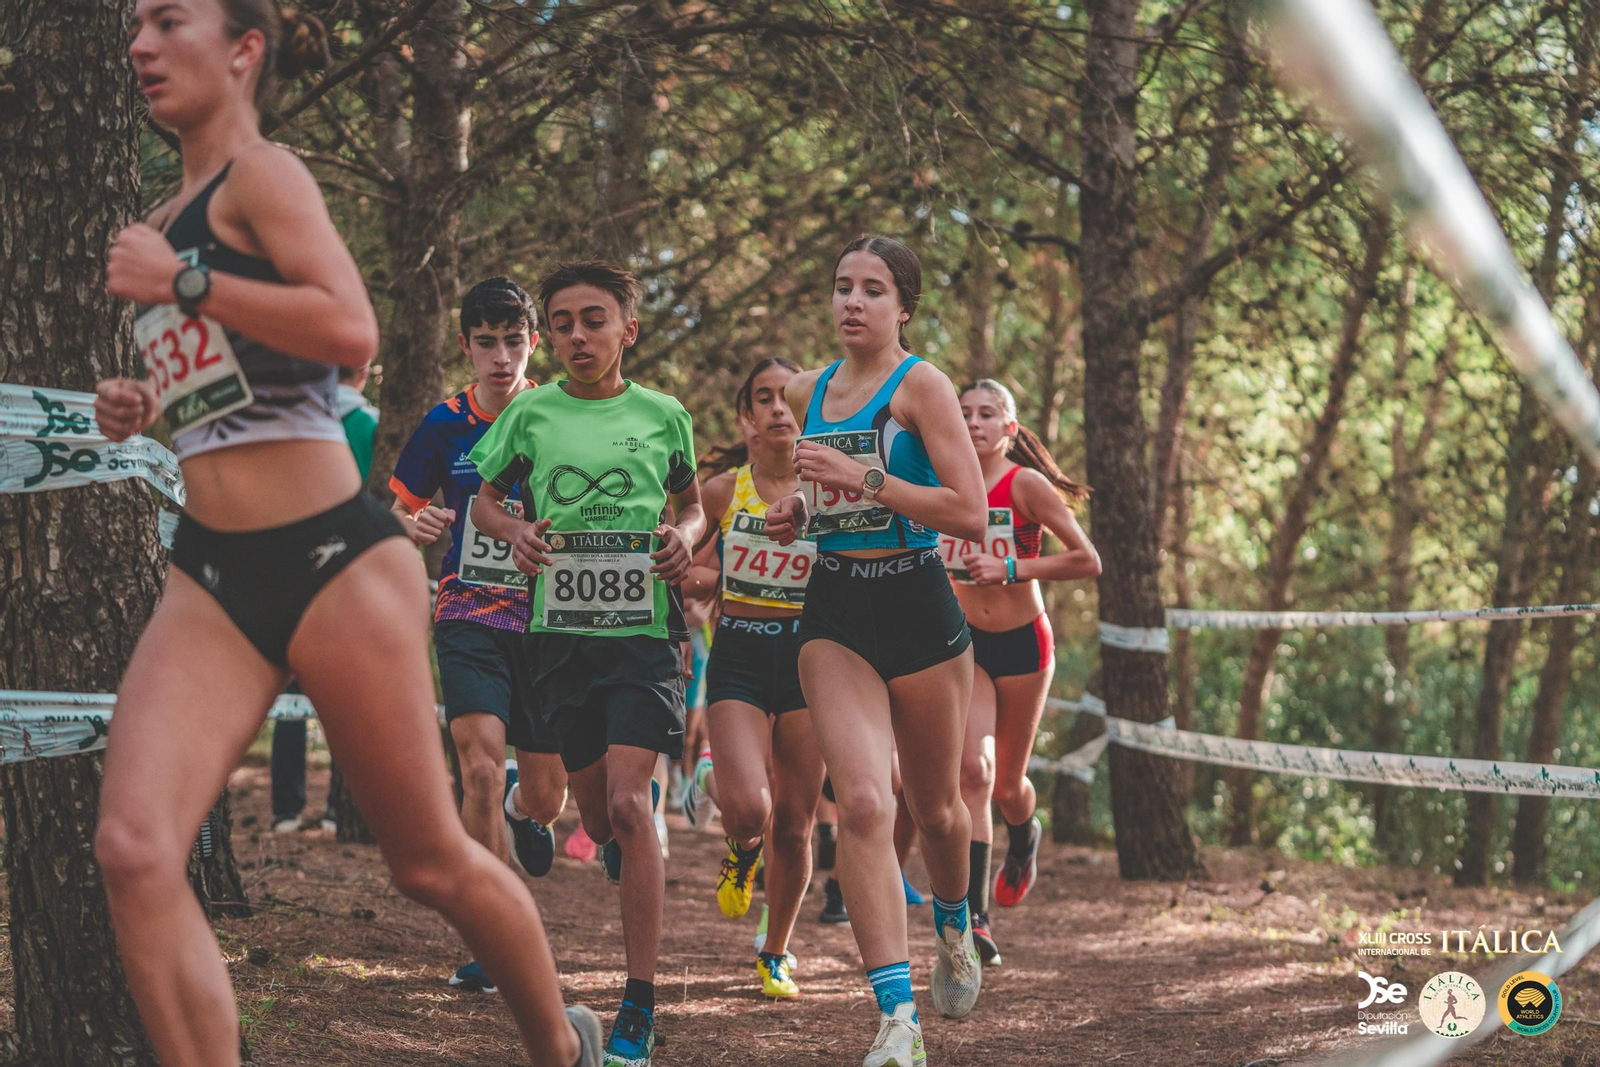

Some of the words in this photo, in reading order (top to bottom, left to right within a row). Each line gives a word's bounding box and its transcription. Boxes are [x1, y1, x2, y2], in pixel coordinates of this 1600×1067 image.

[612, 441, 650, 449] MARBELLA
[580, 503, 624, 517] Infinity
[471, 531, 512, 561] 59
[572, 533, 624, 547] ITÁLICA
[732, 545, 811, 581] 7479
[850, 555, 914, 579] NIKE
[554, 569, 646, 602] 8088
[731, 618, 783, 635] PRO
